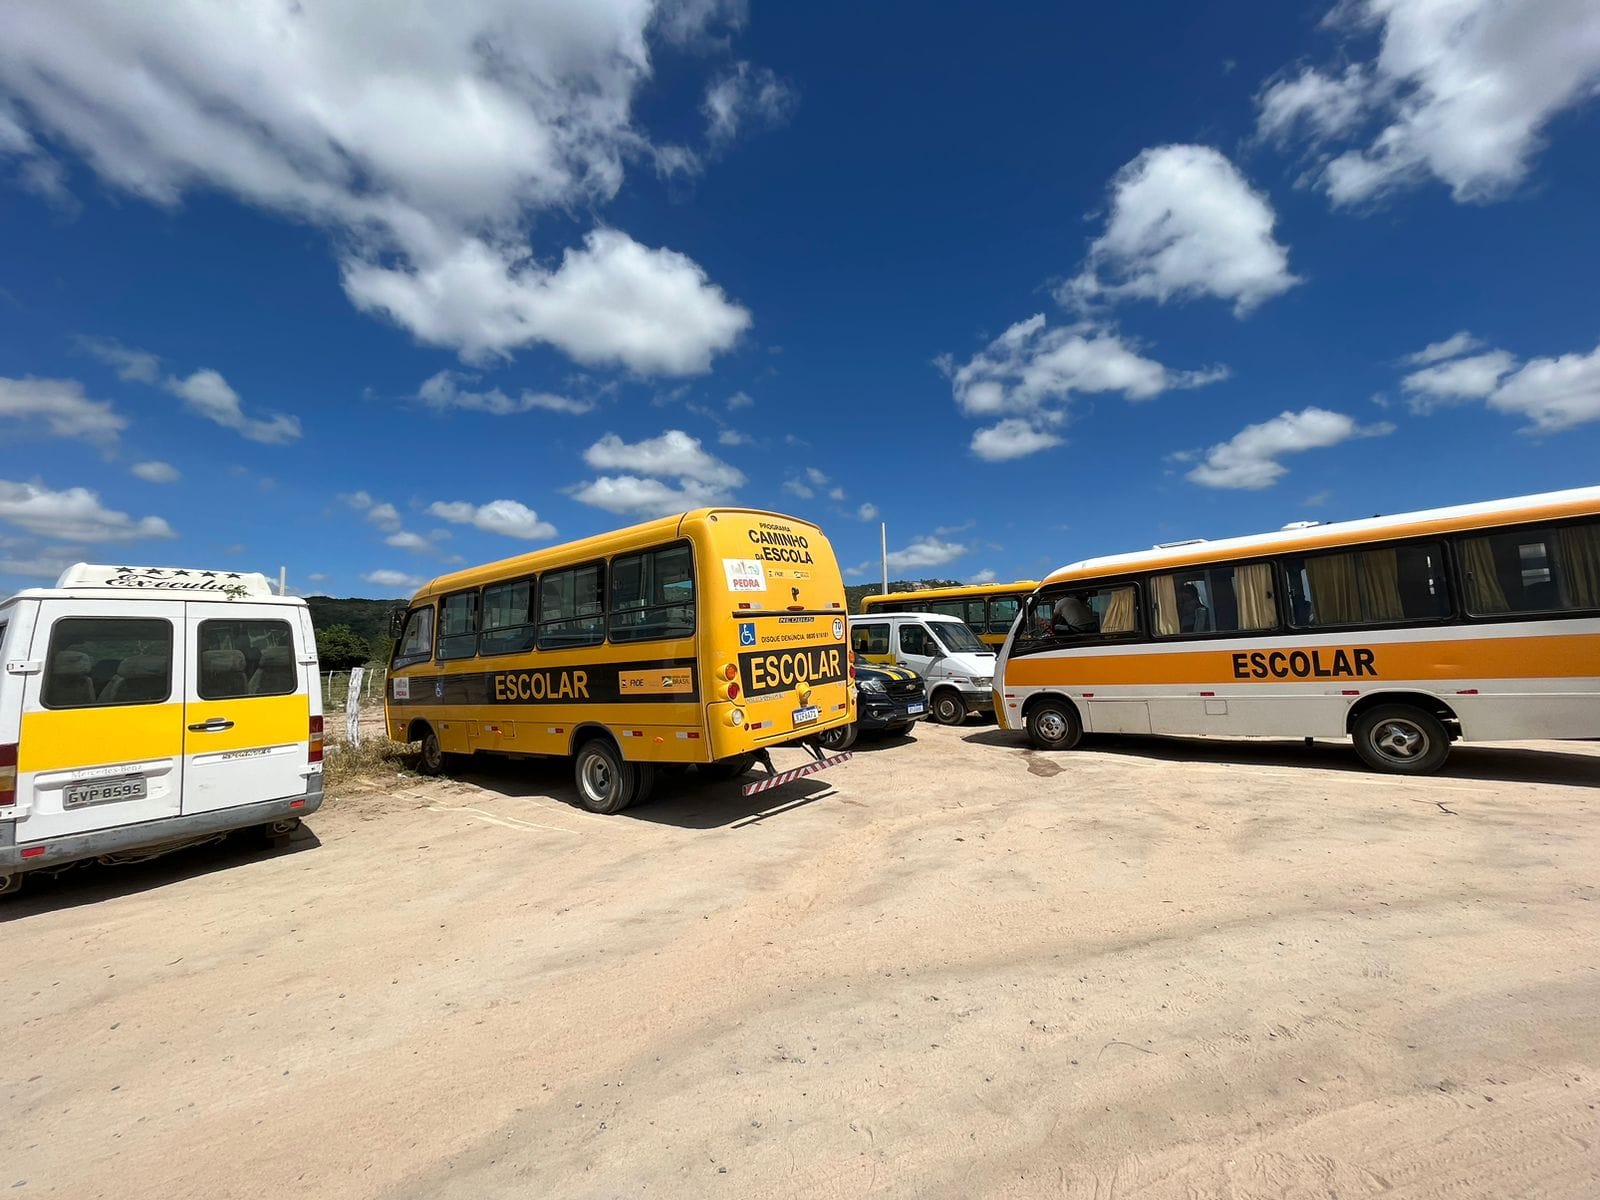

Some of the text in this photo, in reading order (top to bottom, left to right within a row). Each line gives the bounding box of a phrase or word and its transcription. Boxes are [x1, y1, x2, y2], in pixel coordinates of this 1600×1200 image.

[758, 522, 792, 532] PROGRAMA
[748, 529, 809, 549] CAMINHO
[754, 546, 814, 565] DA ESCOLA
[733, 579, 761, 588] PEDRA
[761, 635, 781, 644] DISQUE
[750, 649, 841, 690] ESCOLAR
[1231, 648, 1378, 679] ESCOLAR
[494, 670, 590, 700] ESCOLAR
